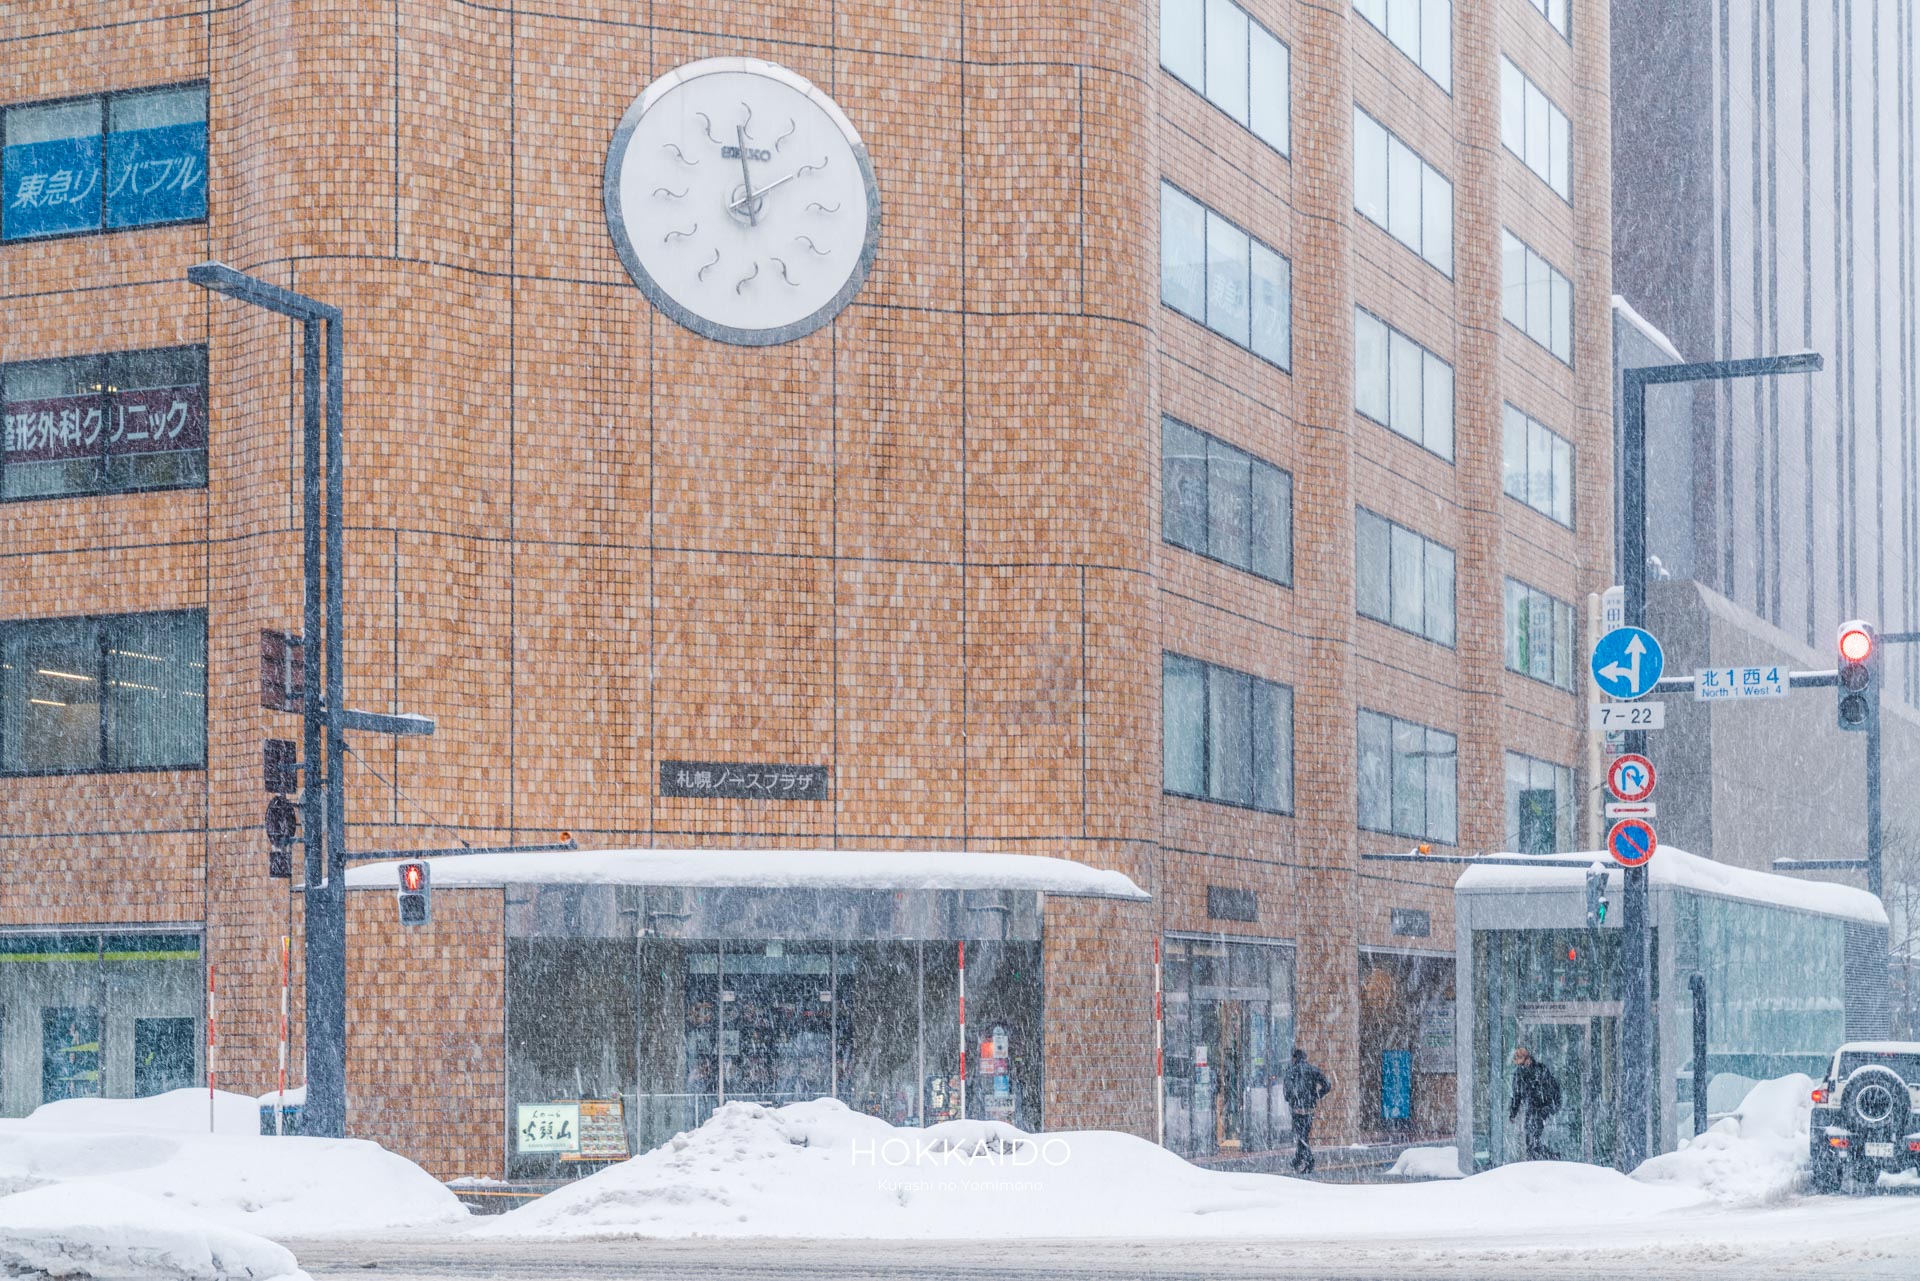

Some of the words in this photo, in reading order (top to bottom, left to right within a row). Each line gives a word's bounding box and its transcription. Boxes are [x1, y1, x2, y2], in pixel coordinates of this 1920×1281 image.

[10, 155, 203, 208] 東急リバブル
[1702, 688, 1729, 698] North
[1744, 686, 1769, 696] West
[1775, 685, 1781, 694] 4
[676, 769, 813, 791] 札幌ノースプラザ
